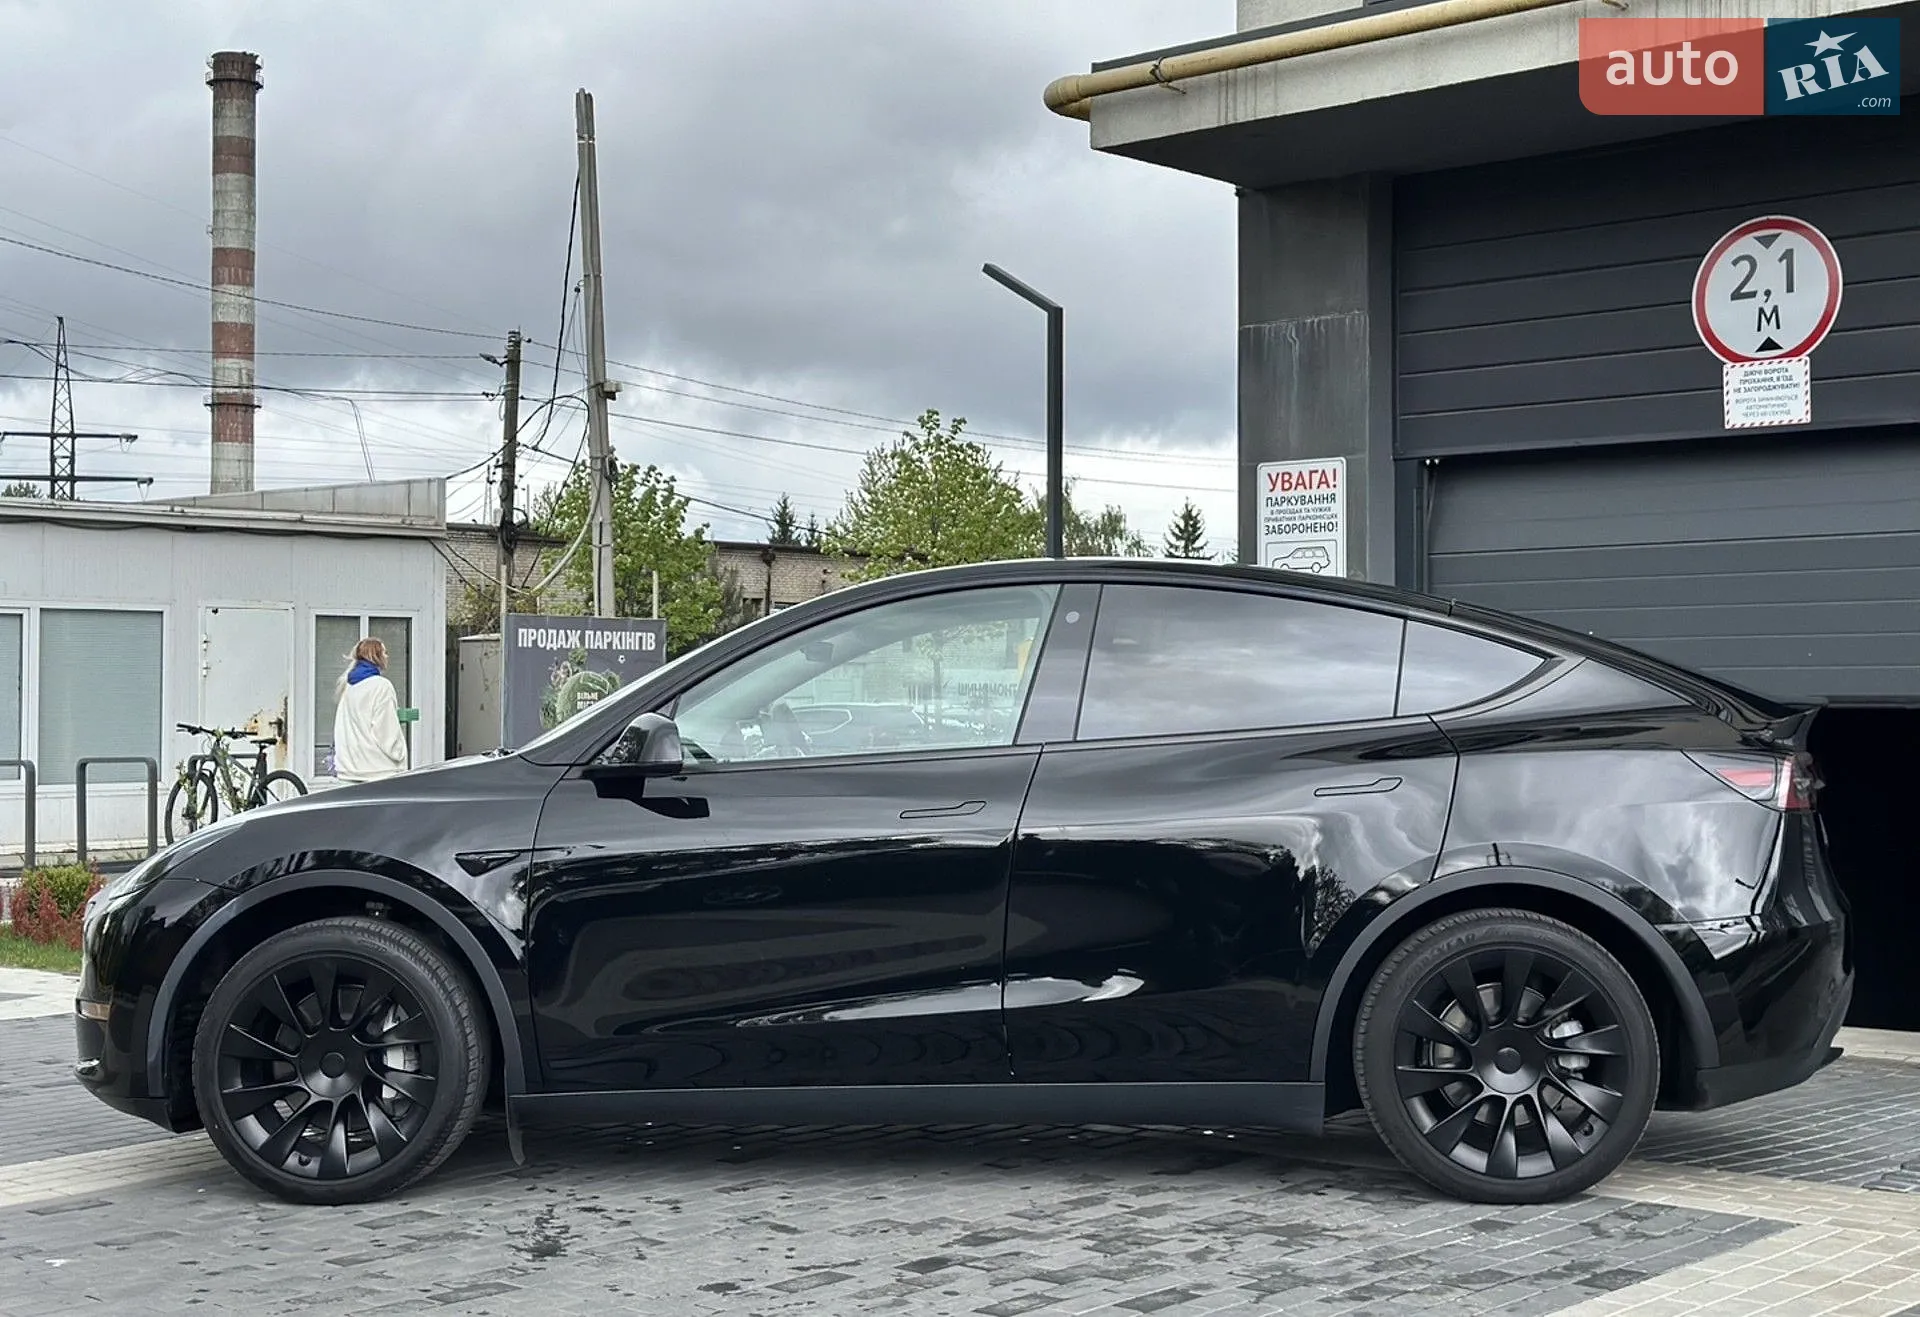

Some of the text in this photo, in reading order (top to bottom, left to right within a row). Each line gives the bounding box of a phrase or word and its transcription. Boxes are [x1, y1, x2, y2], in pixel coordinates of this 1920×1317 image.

[1730, 248, 1794, 303] 2,1
[1764, 367, 1789, 375] ВОРОТА
[1267, 468, 1337, 492] УВАГА!
[1266, 493, 1337, 507] ПАРКУВАННЯ
[1264, 521, 1338, 536] ЗАБОРОНЕНО!
[518, 628, 656, 651] ПРОДАЖ ПАРКІНГІВ
